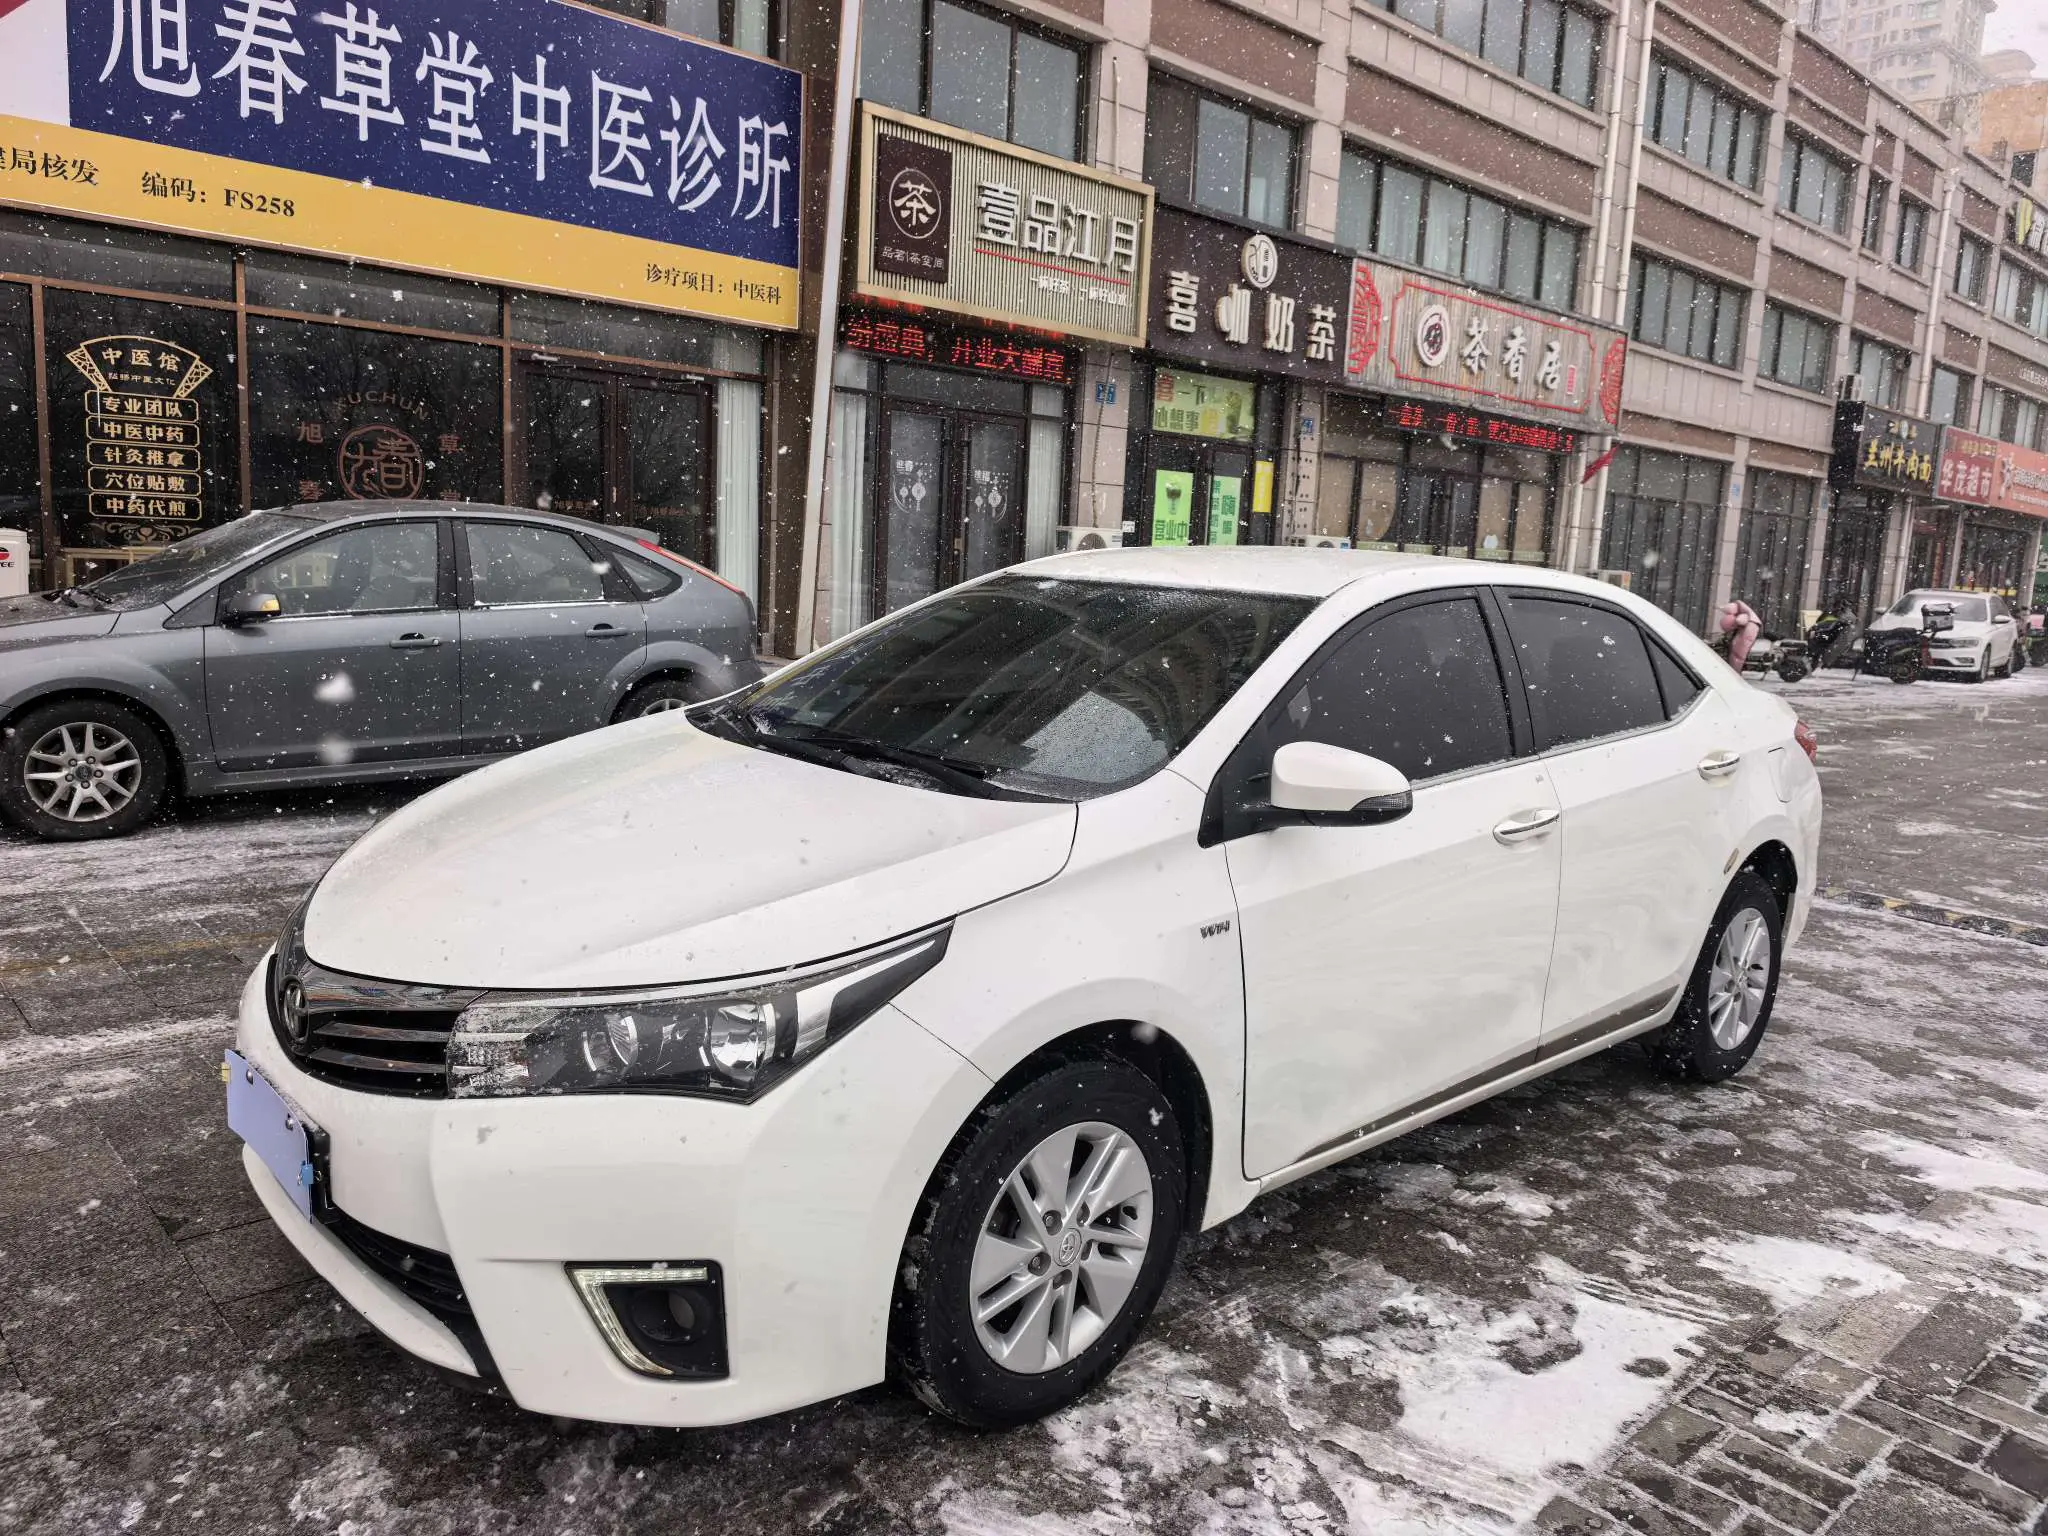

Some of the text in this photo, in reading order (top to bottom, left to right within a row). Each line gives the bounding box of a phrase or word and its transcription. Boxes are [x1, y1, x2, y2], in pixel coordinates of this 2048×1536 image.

[99, 0, 789, 229] 旭春草堂中医诊所
[894, 180, 937, 227] 茶
[976, 181, 1139, 273] 壹品江月
[646, 263, 782, 305] 诊疗项目：中医科
[102, 348, 181, 372] 中医馆
[1462, 316, 1561, 389] 茶香居
[103, 397, 183, 418] 专业团队
[103, 422, 184, 443] 中医中药
[104, 446, 185, 467] 针灸推拿
[1864, 438, 1932, 483] 兰州牛肉面
[105, 473, 185, 493] 穴位贴敷
[106, 498, 187, 517] 中药代煎
